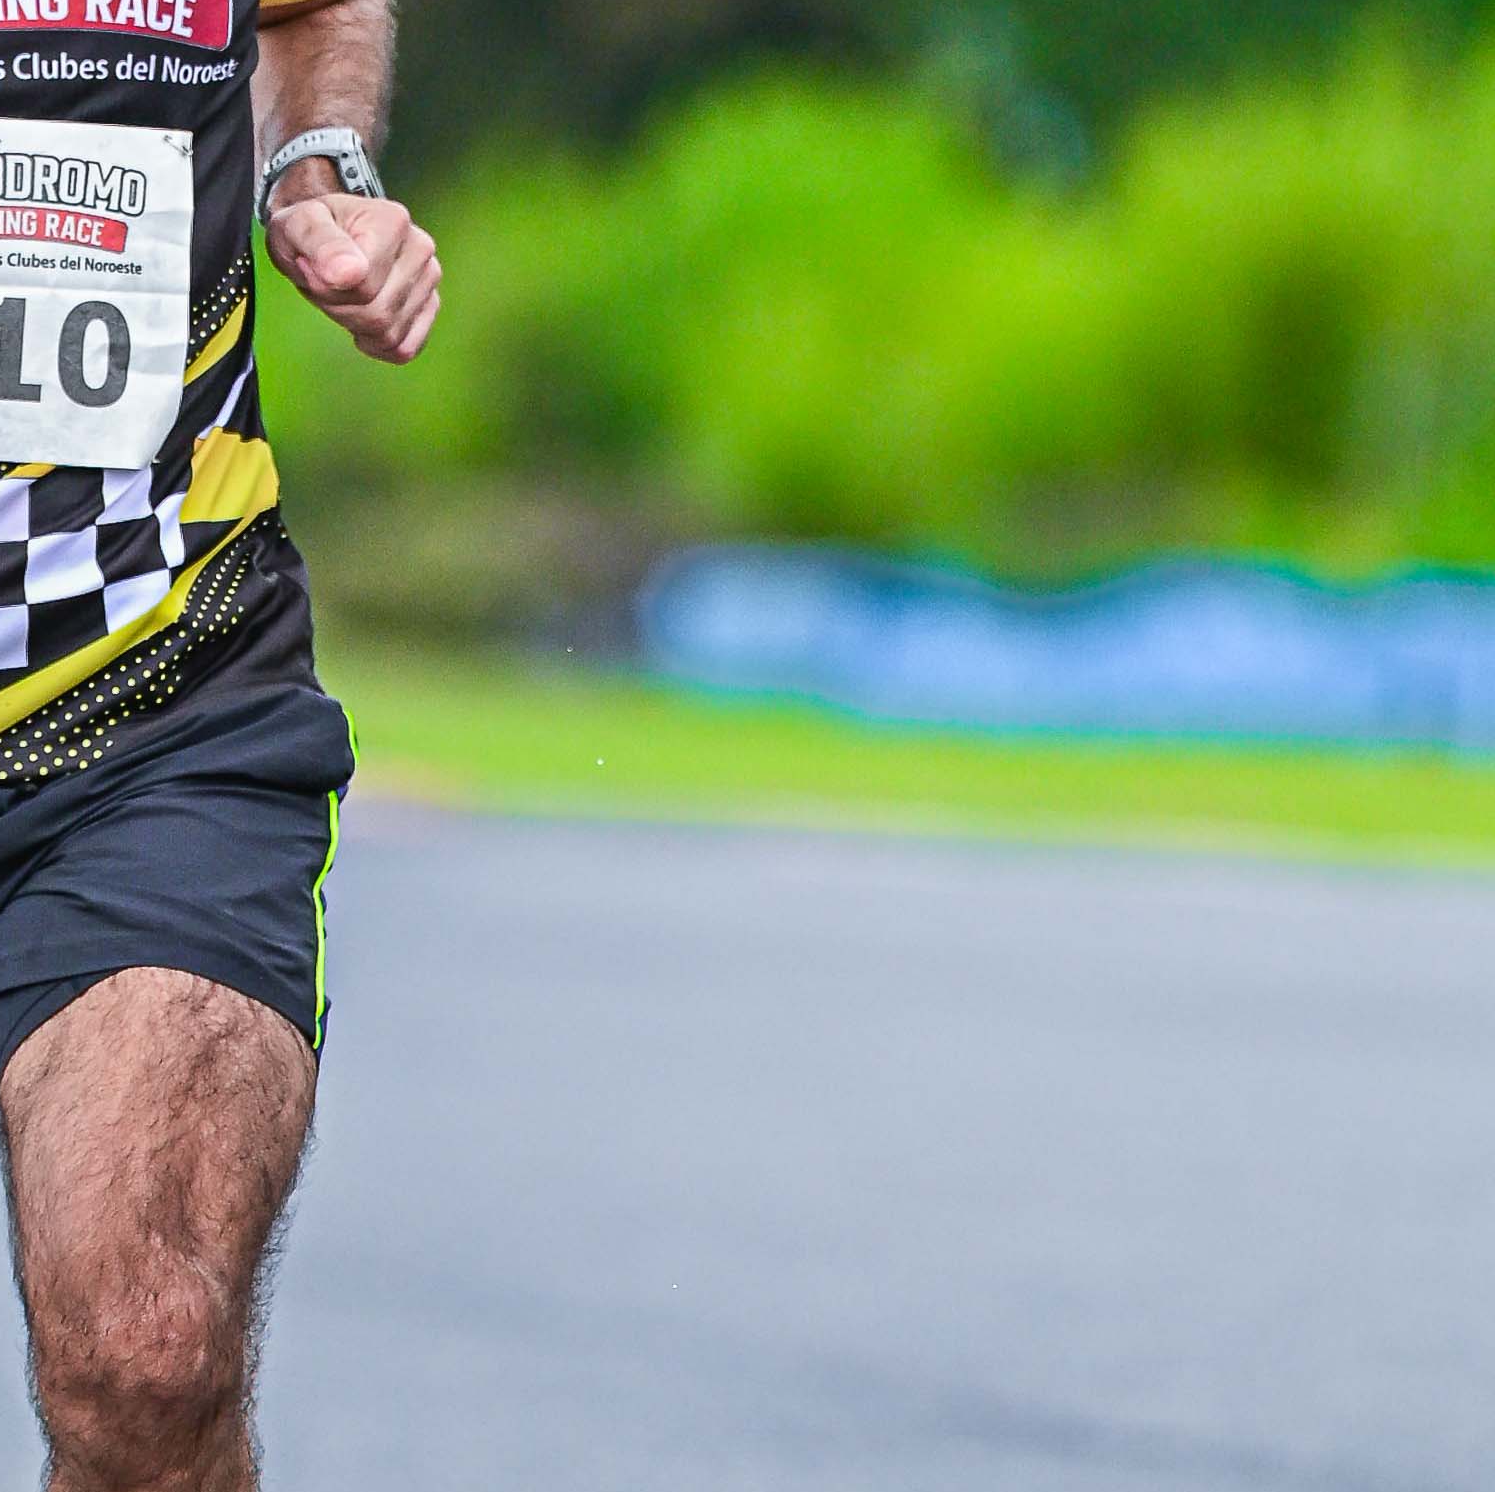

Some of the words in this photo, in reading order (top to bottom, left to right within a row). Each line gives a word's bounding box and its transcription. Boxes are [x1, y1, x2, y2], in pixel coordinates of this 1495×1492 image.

[12, 52, 109, 81] Clubes
[115, 54, 155, 81] del
[161, 55, 239, 85] Noroest
[45, 214, 105, 246] RACE
[7, 253, 55, 269] Clubes
[59, 255, 81, 271] del
[84, 259, 143, 275] Noroeste
